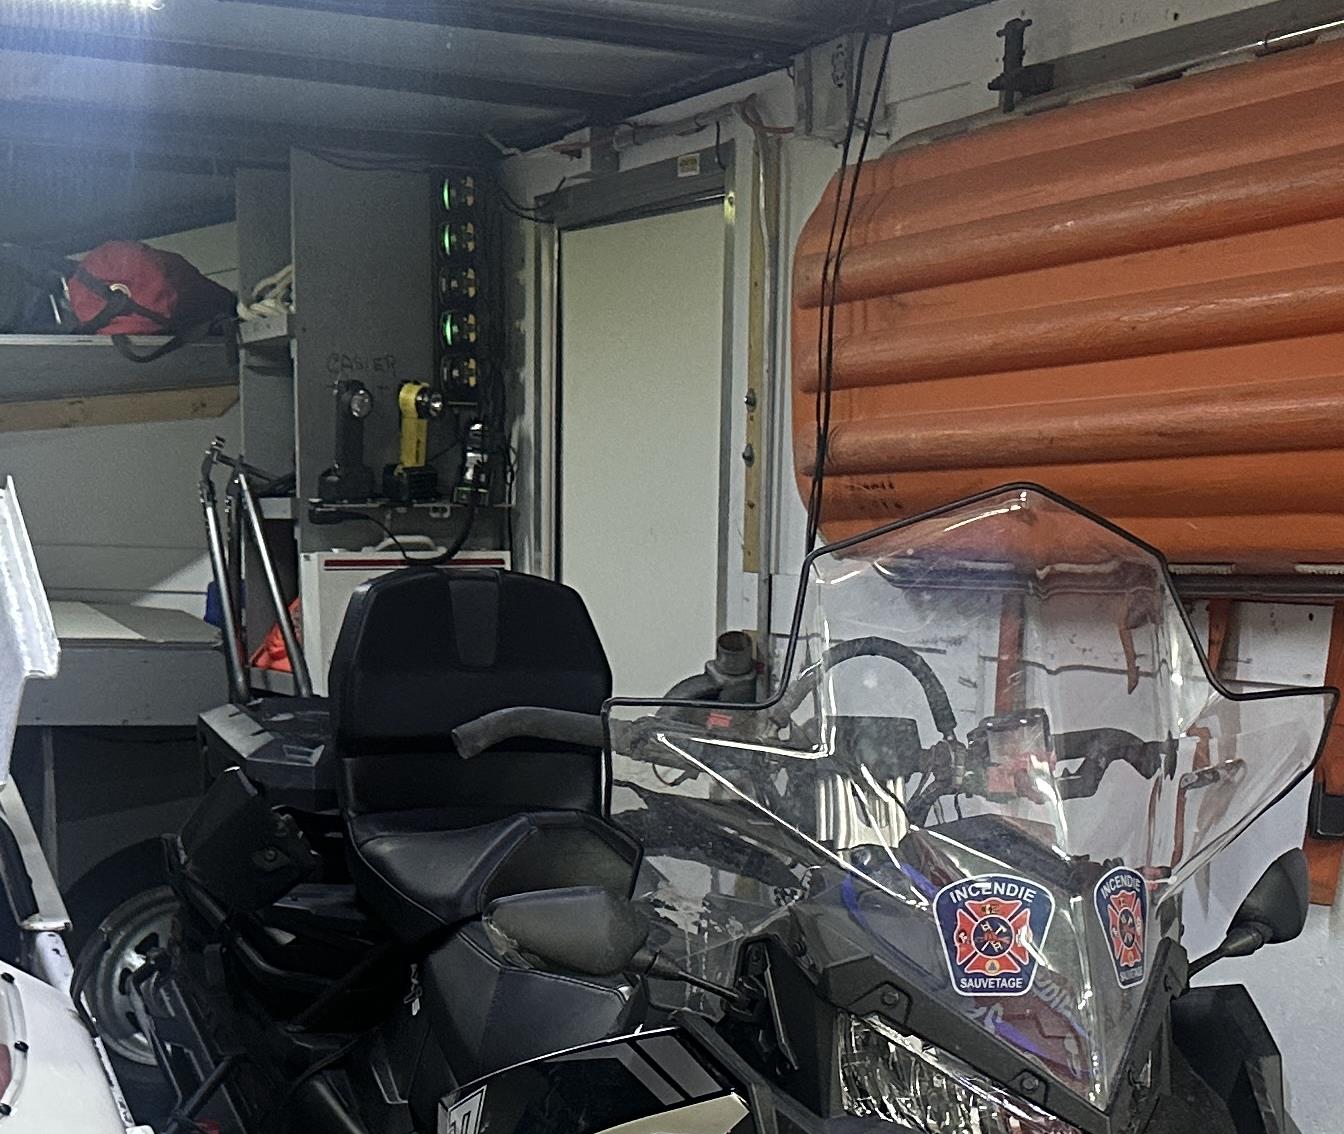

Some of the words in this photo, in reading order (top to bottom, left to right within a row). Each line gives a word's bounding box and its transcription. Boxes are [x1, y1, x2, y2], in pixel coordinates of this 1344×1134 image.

[327, 353, 397, 377] CASIER
[949, 881, 1038, 904] INCENDIE
[1099, 874, 1142, 899] INCENDIE
[959, 976, 1024, 990] SAUVETAGE
